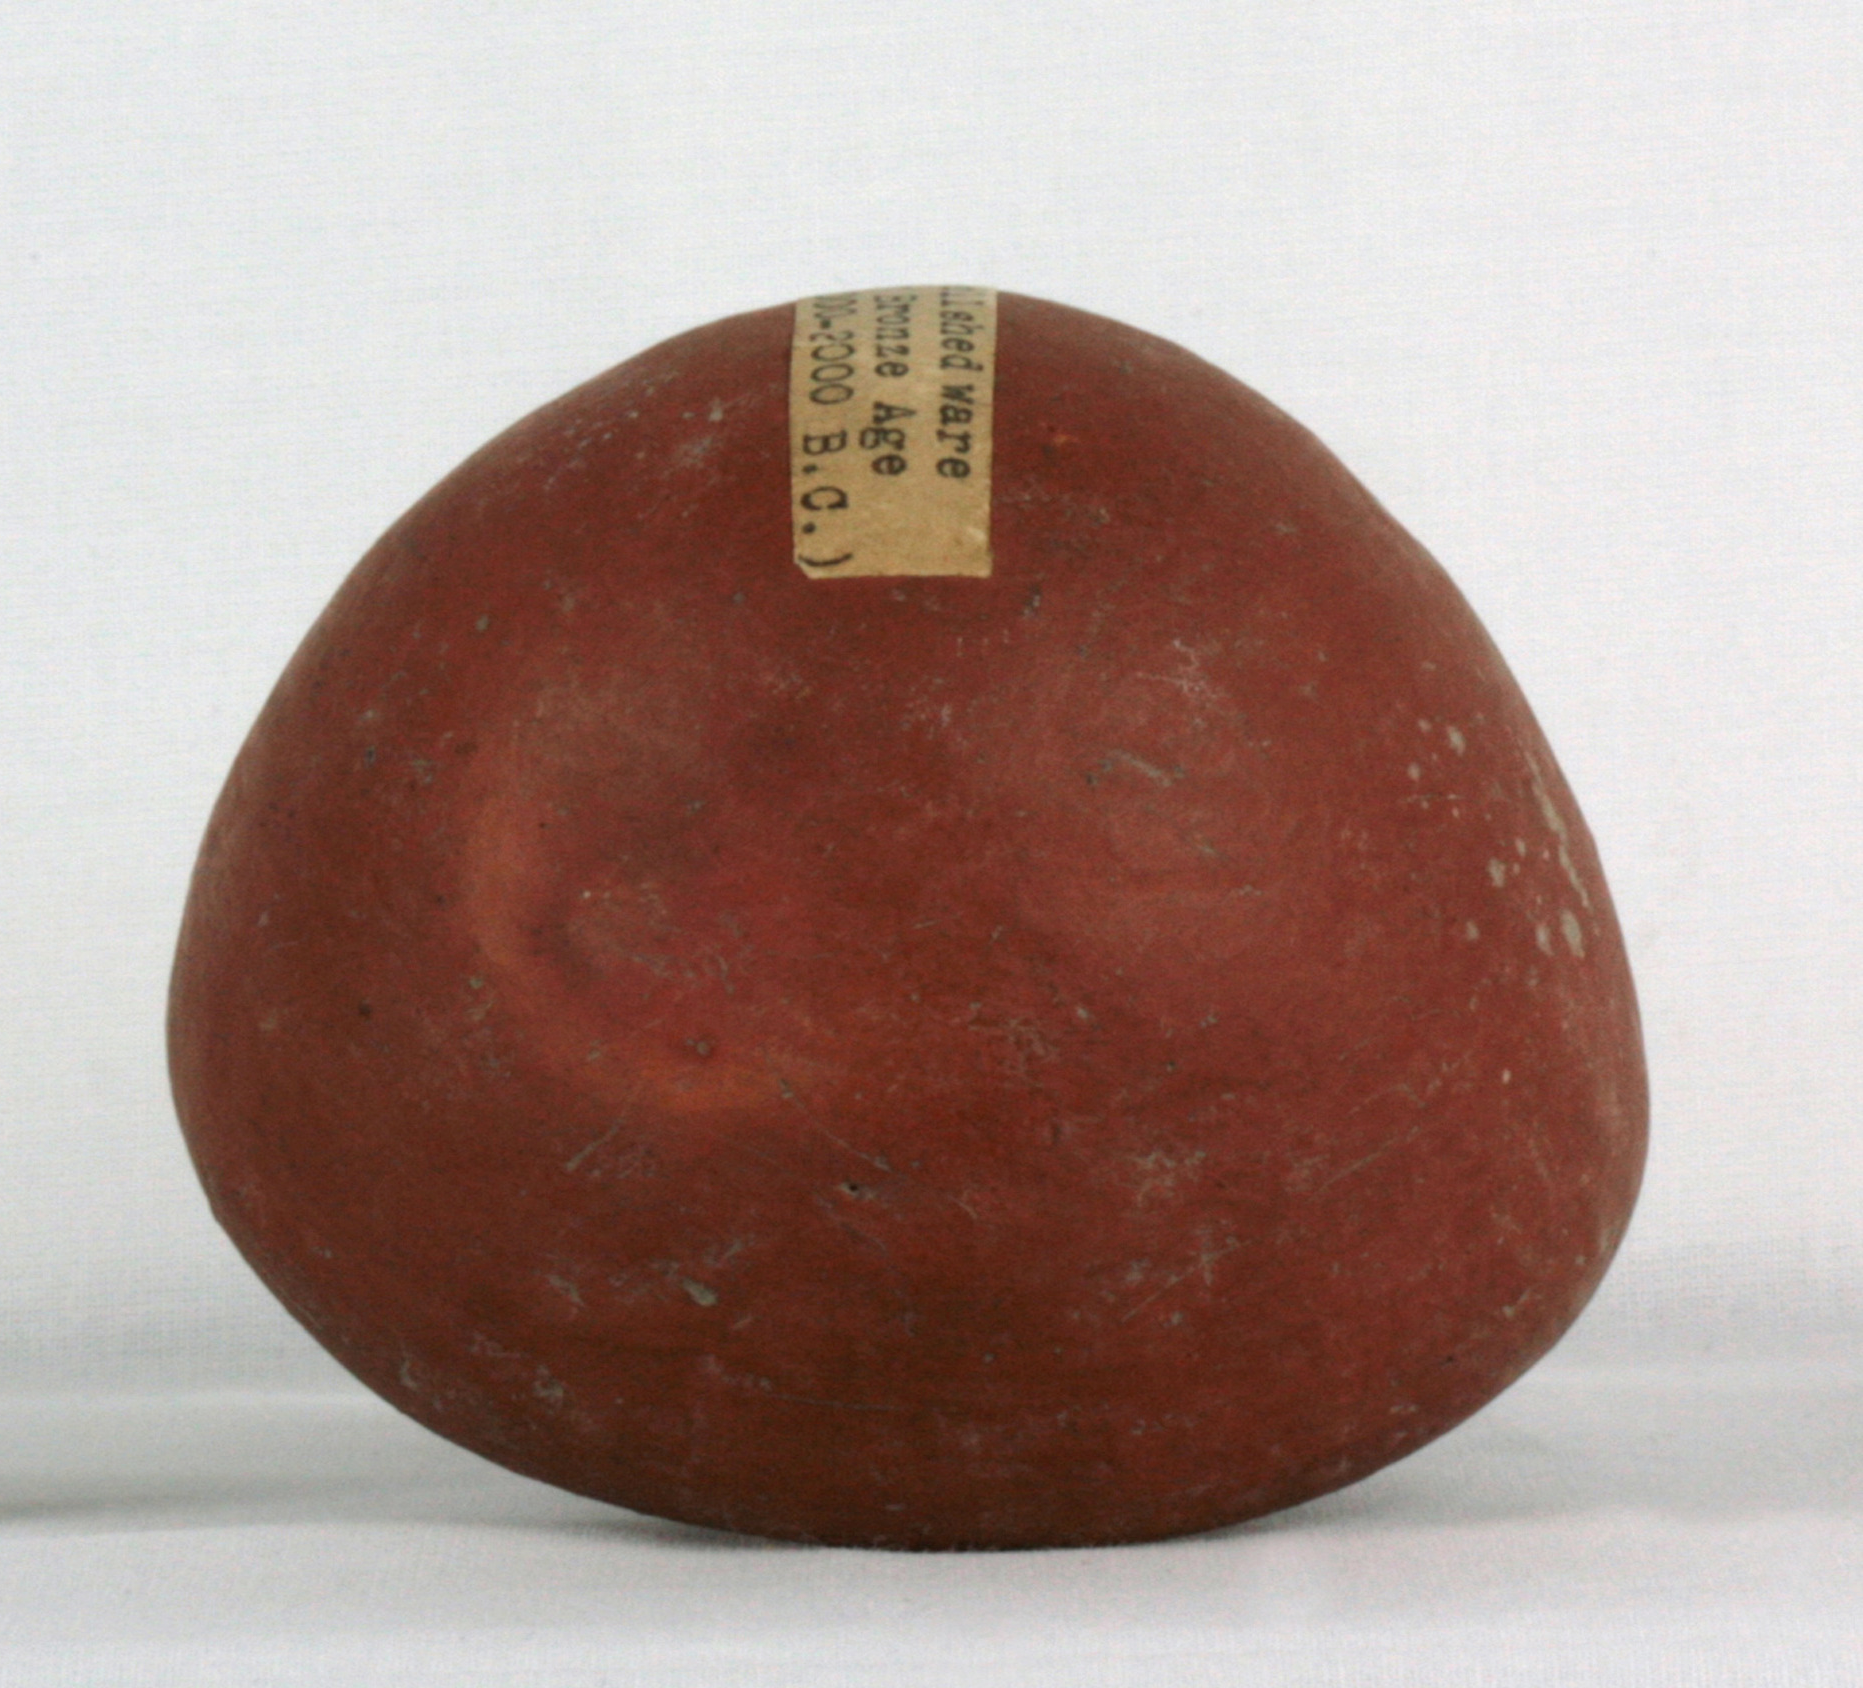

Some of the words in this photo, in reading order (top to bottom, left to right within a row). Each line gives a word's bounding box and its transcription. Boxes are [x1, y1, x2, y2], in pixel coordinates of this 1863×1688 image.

[859, 400, 917, 477] Age
[936, 384, 974, 479] ware
[797, 429, 854, 568] B.C.)
